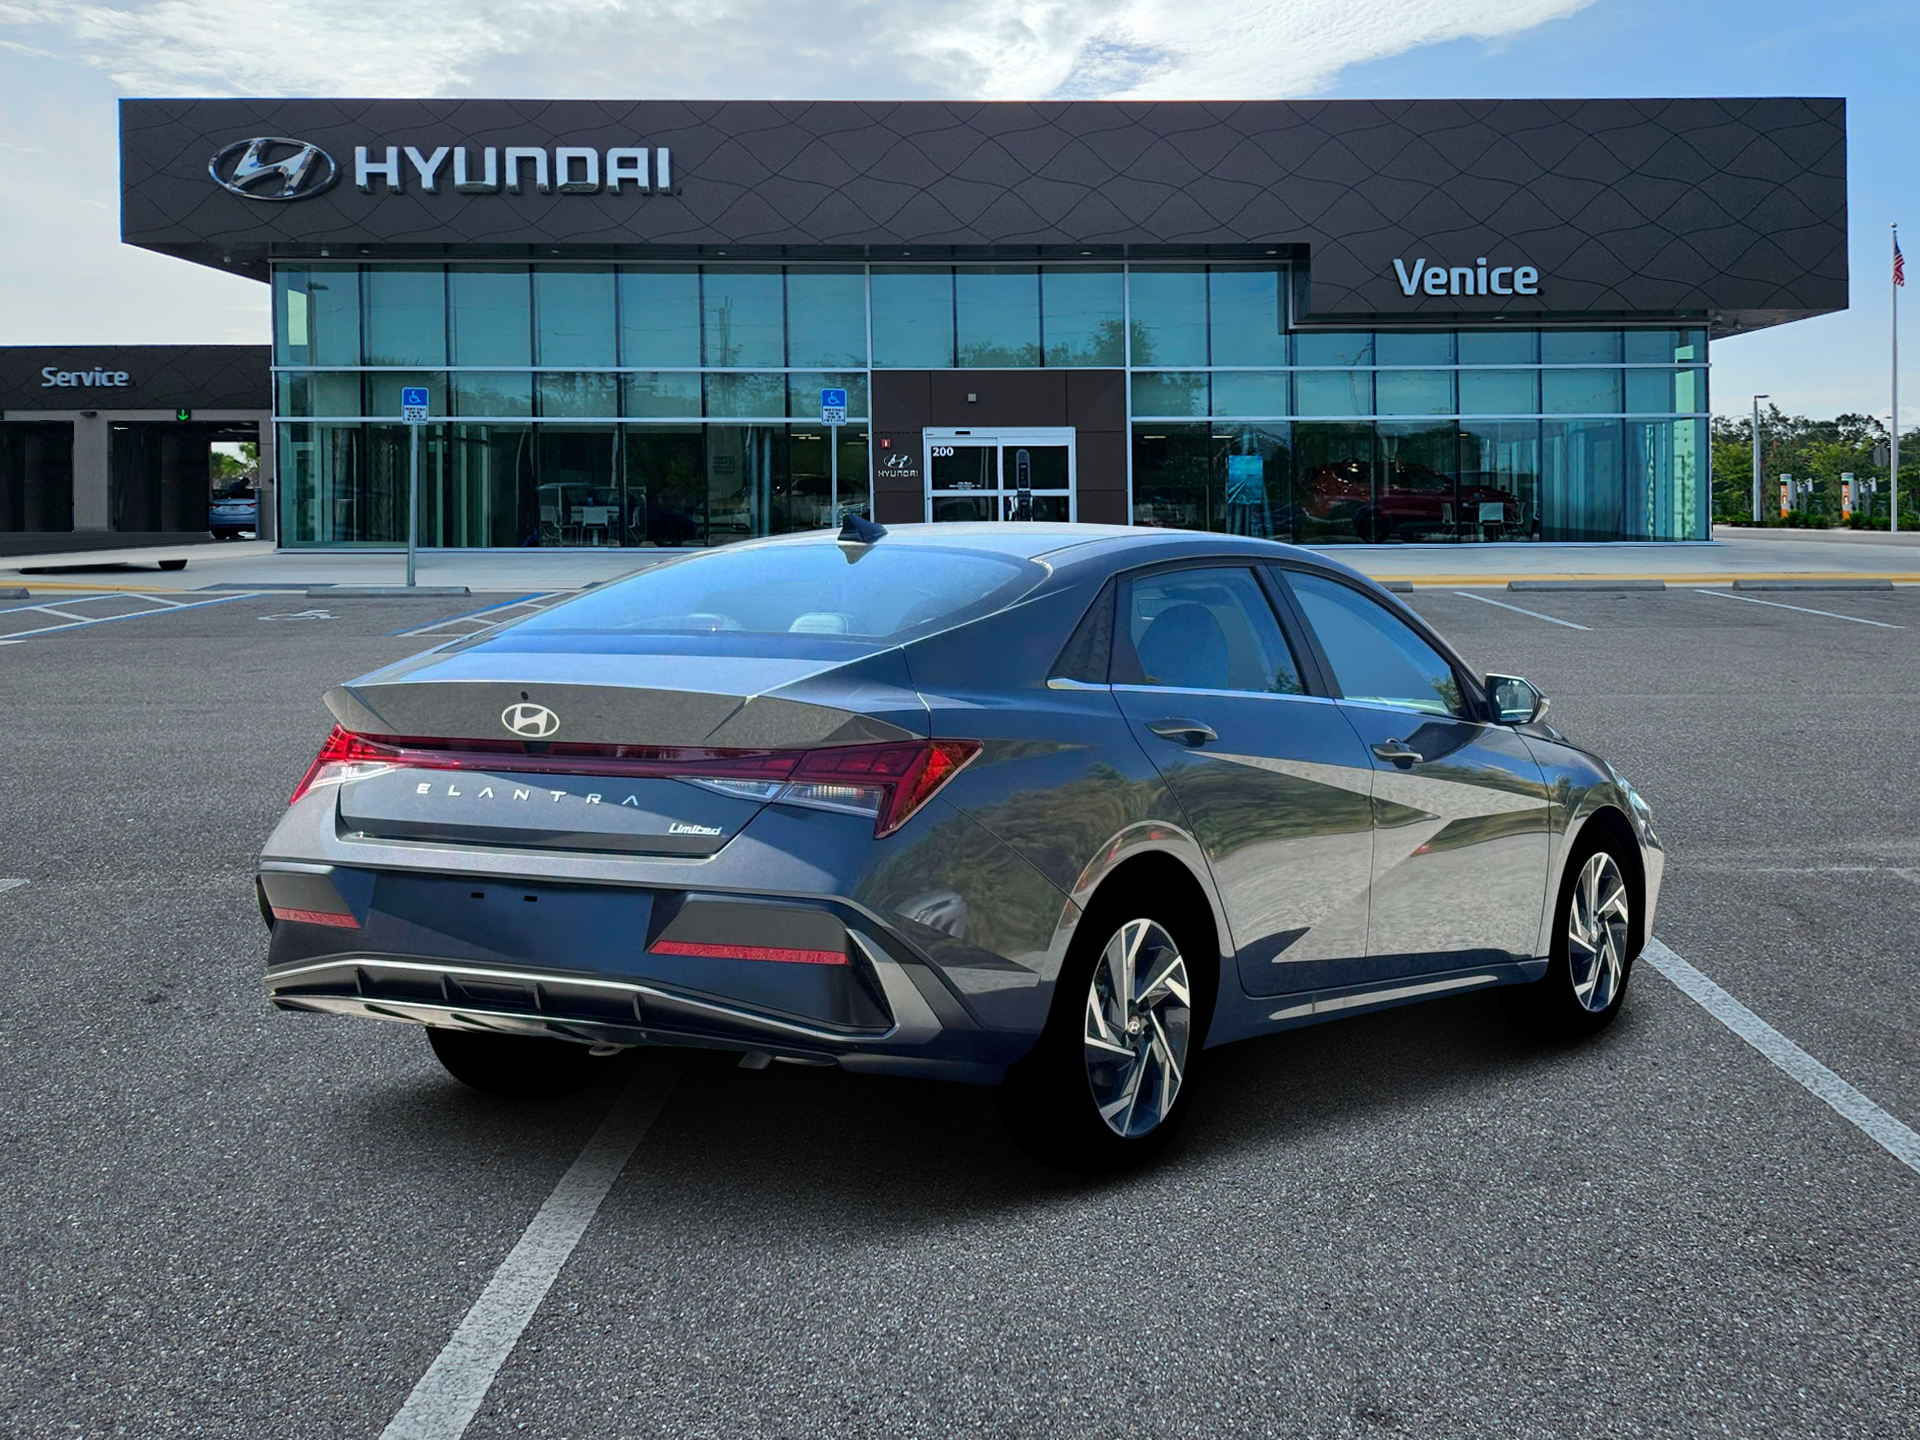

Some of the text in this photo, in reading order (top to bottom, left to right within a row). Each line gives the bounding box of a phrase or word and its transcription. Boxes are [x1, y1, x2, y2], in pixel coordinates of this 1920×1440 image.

[355, 146, 671, 193] HYUNDAI
[1393, 257, 1539, 296] Venice
[41, 366, 130, 387] Service
[932, 446, 954, 457] 200
[878, 470, 919, 478] HYUNDAI
[416, 782, 639, 806] ELANTRA
[668, 822, 722, 836] Limited
